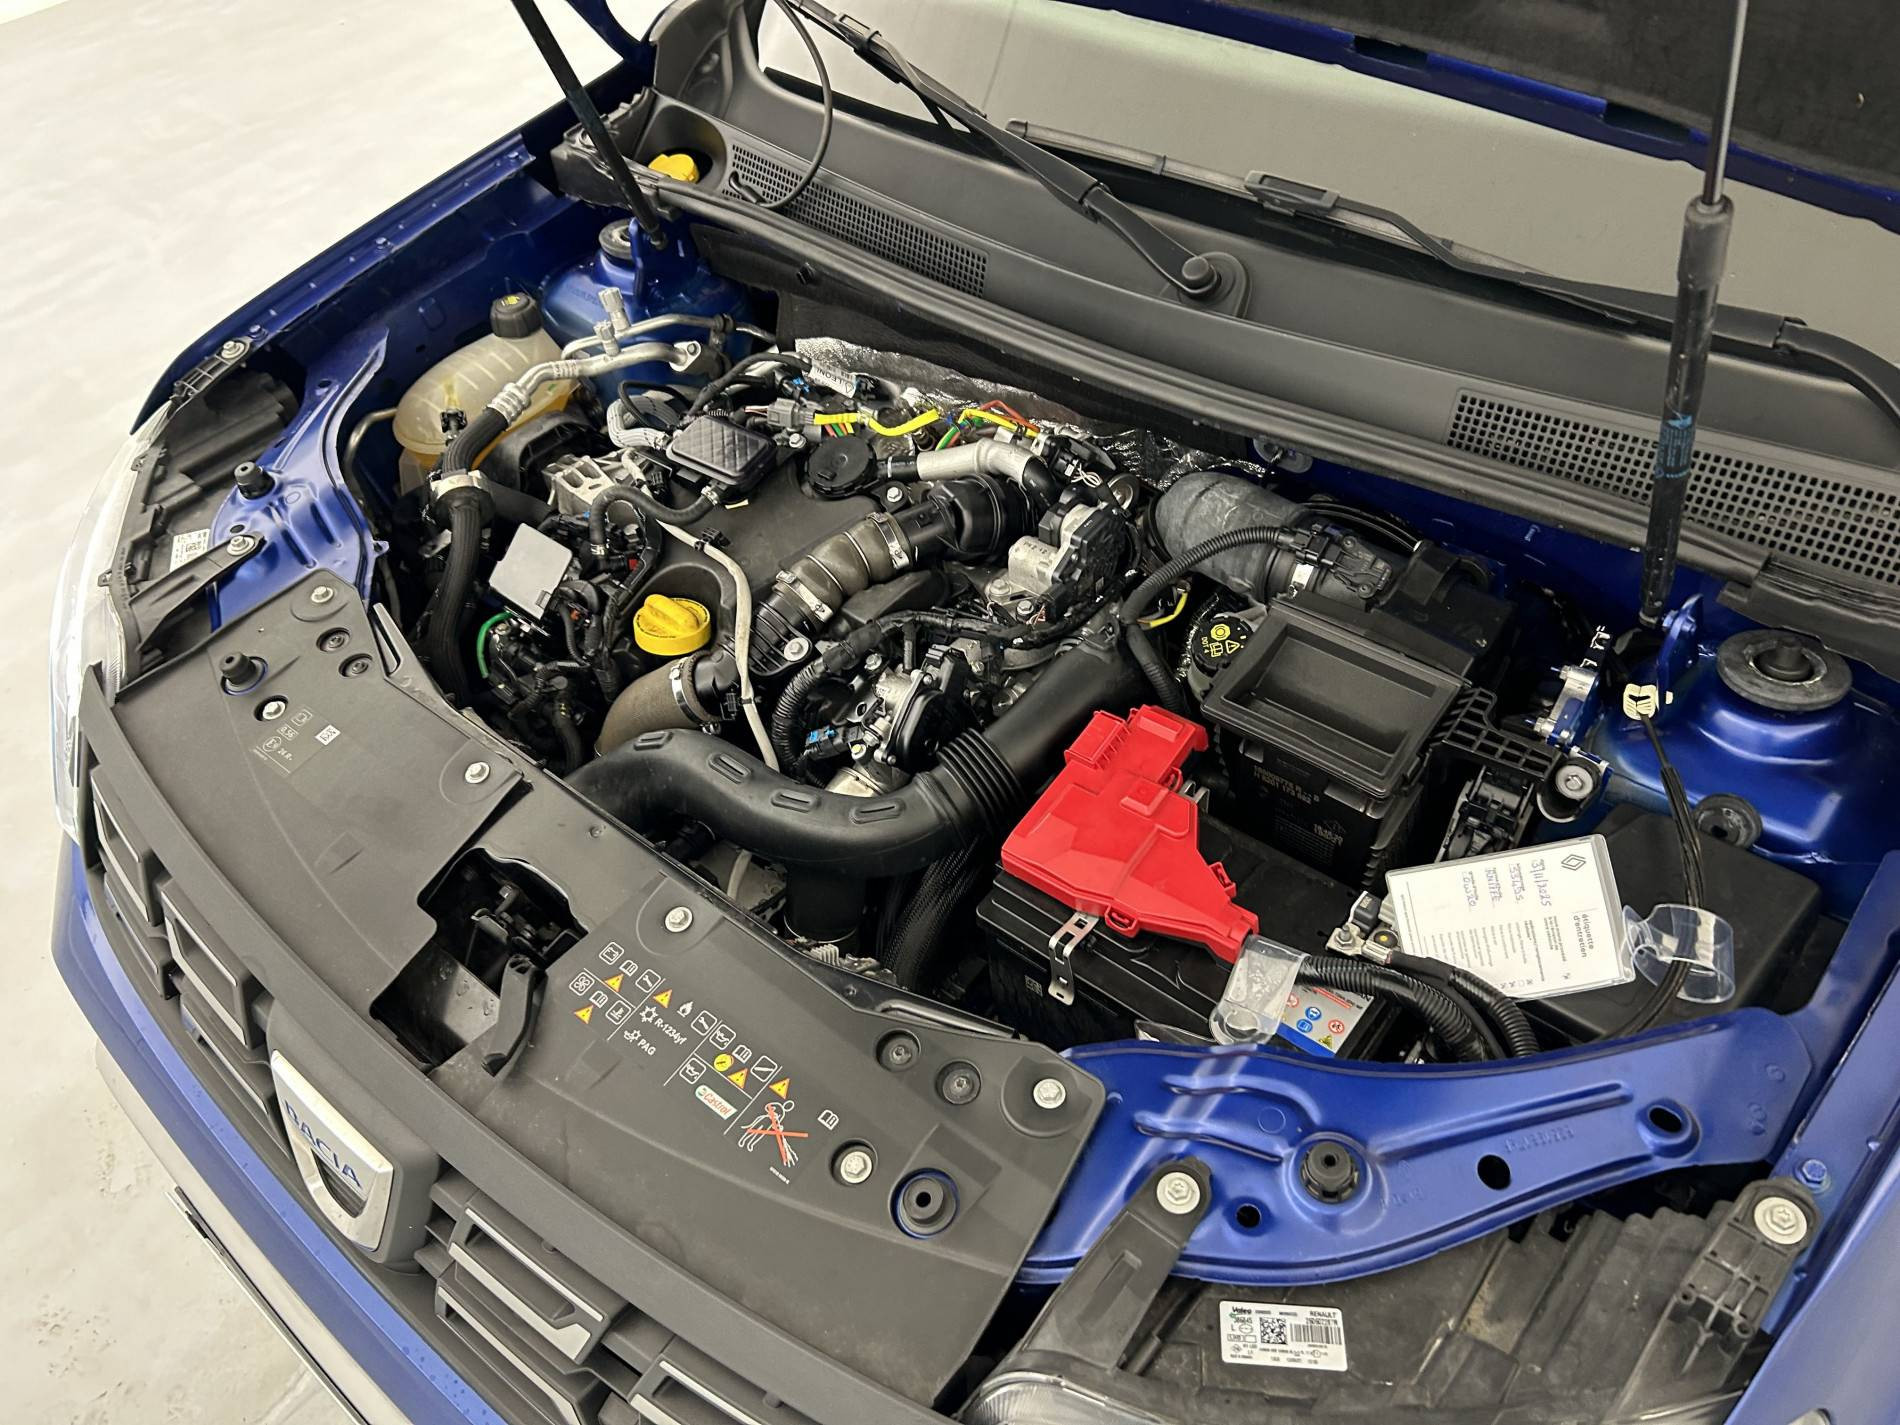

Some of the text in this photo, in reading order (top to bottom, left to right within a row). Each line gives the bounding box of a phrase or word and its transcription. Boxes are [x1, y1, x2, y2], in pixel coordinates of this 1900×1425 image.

[1201, 636, 1209, 648] DOT
[1573, 915, 1588, 957] d'entretien
[1581, 913, 1594, 950] étiquette
[654, 1018, 687, 1044] R-1234yf
[637, 1037, 657, 1056] PAG
[702, 1092, 732, 1116] Castrol
[284, 1099, 361, 1188] DACIA
[1309, 1310, 1337, 1319] RENAULT
